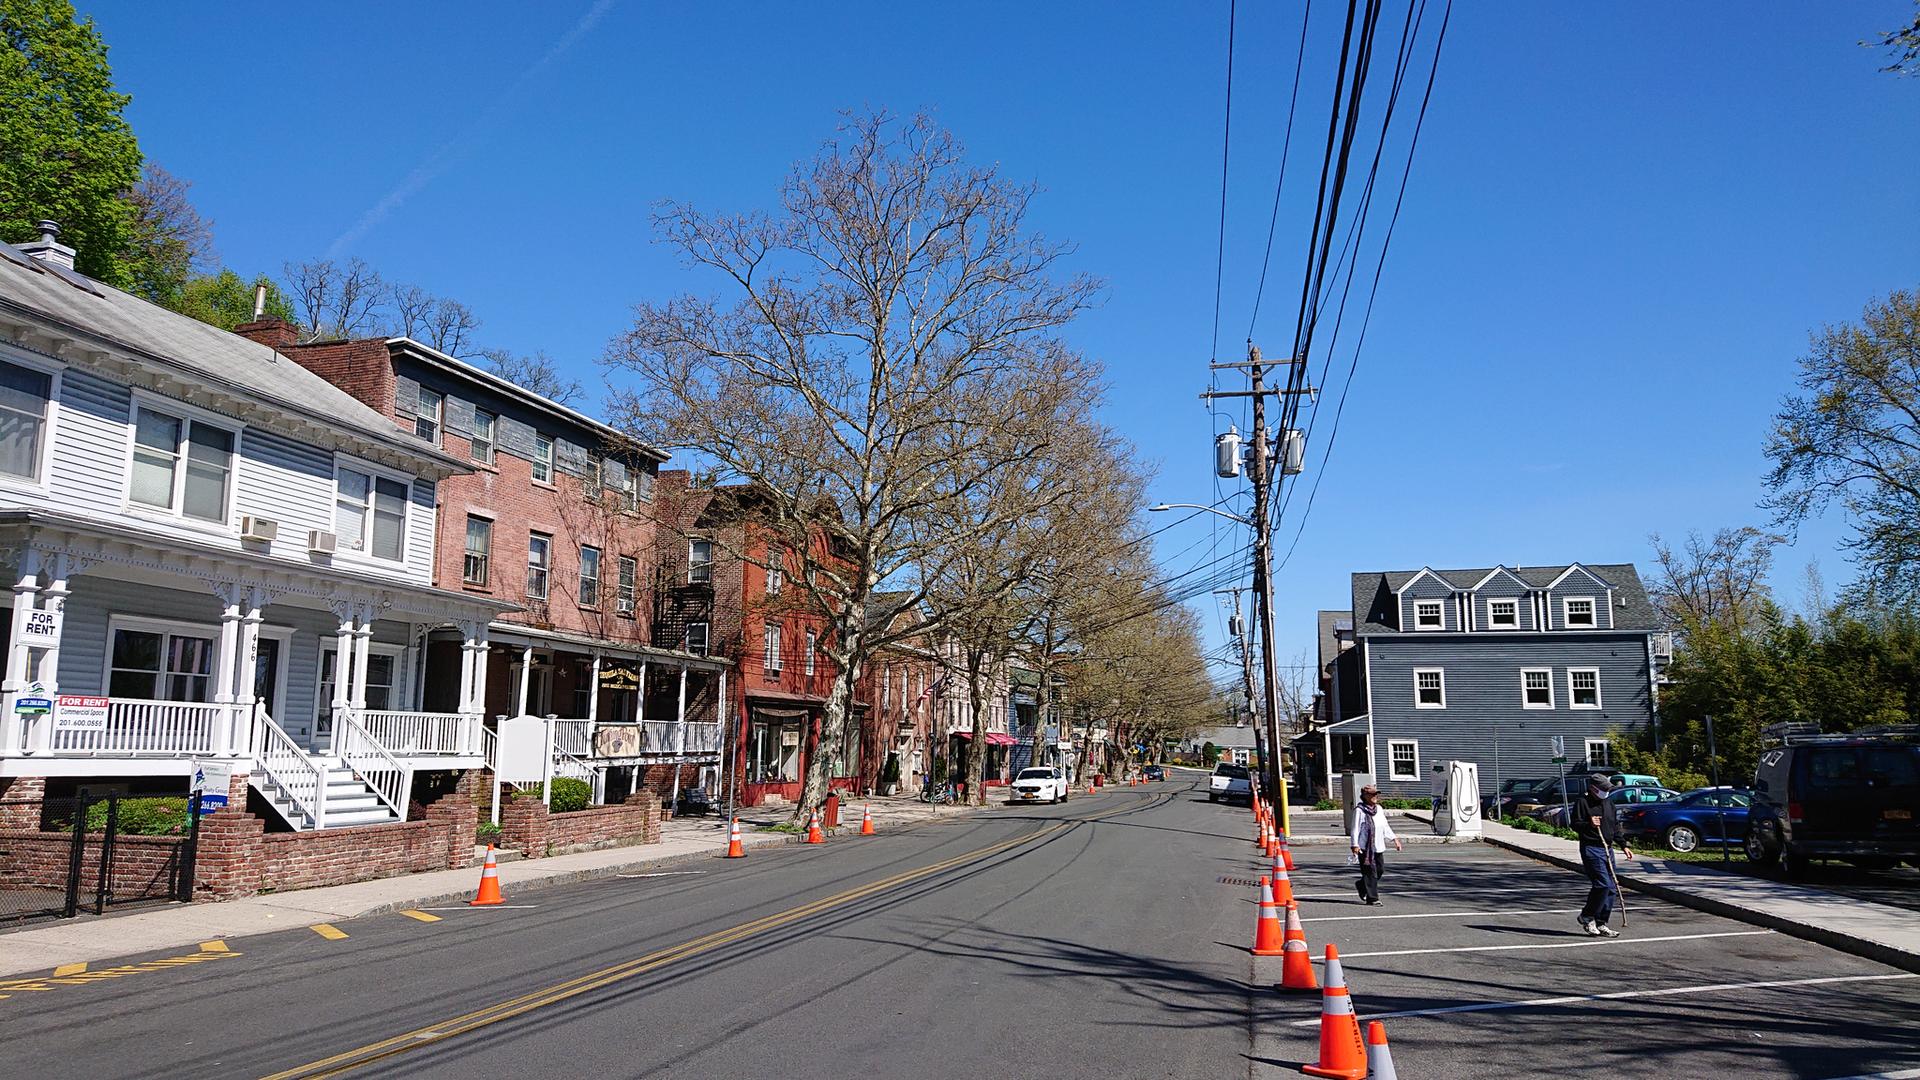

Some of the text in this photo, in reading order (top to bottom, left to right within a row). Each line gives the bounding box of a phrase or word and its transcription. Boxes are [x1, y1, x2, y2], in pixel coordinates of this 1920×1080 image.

[31, 612, 53, 624] FOR
[26, 622, 56, 635] RENT
[61, 697, 107, 707] FOR RENT
[60, 707, 105, 718] Commercial Space
[59, 719, 103, 727] 201.600.0555
